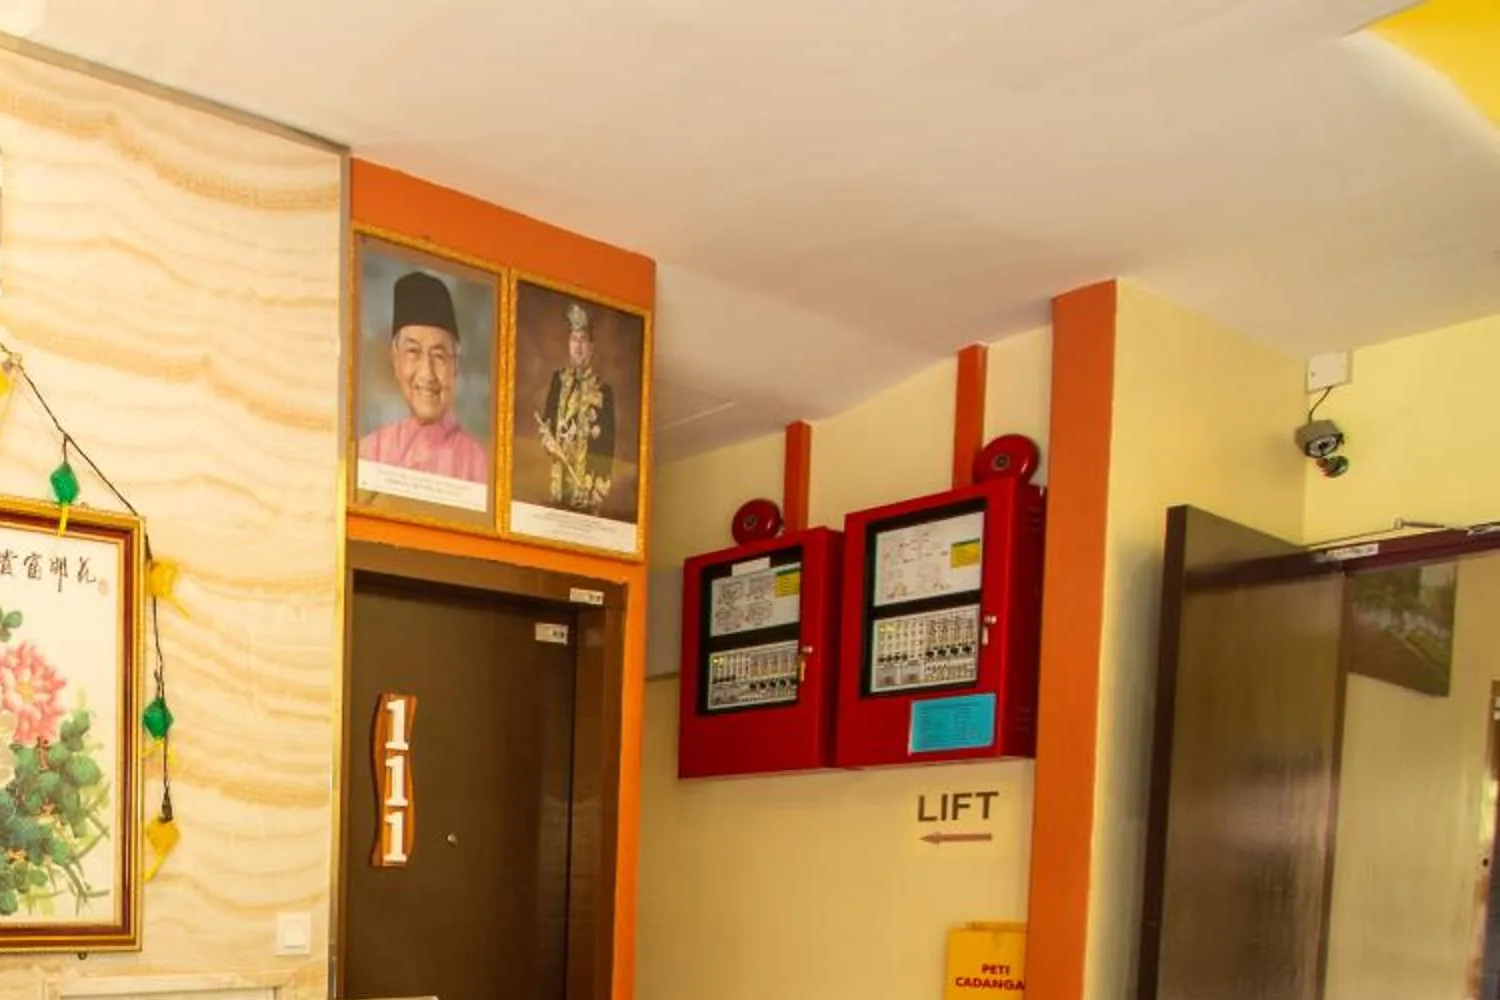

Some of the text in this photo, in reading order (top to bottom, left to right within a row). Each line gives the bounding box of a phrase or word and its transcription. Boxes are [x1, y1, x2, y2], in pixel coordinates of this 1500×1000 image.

[383, 699, 409, 862] 111
[917, 791, 999, 822] LIFT
[981, 963, 1011, 976] PETI
